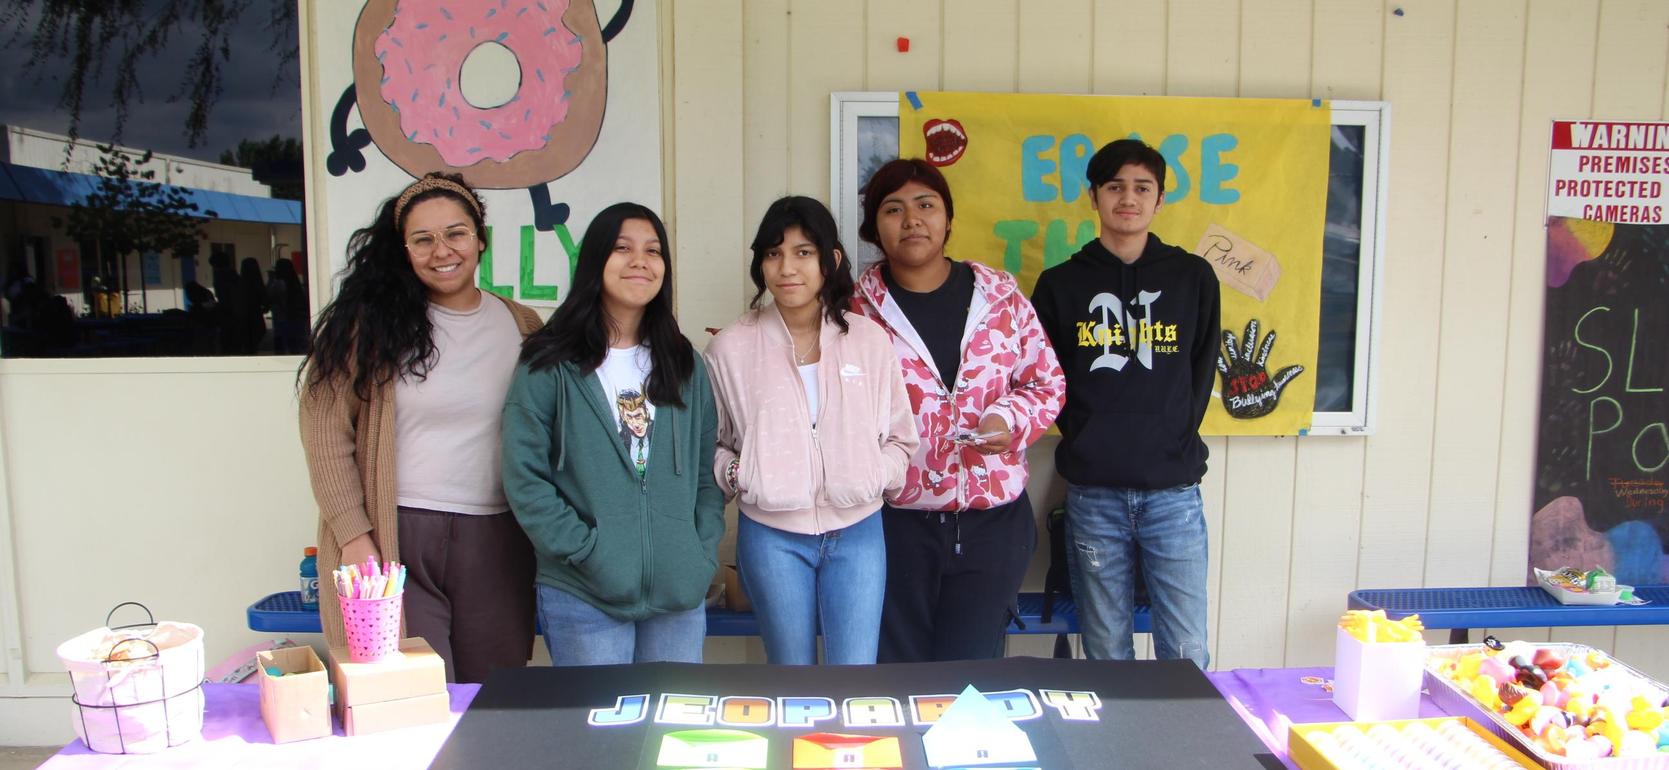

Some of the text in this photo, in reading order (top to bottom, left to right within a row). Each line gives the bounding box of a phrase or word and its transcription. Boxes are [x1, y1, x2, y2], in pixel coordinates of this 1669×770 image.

[1021, 132, 1241, 205] ERSE
[1555, 179, 1661, 198] PROTECTED
[1582, 204, 1662, 223] CAMERAS
[1203, 234, 1254, 275] Pink
[1229, 371, 1267, 396] STOP
[1229, 389, 1277, 409] Bullying
